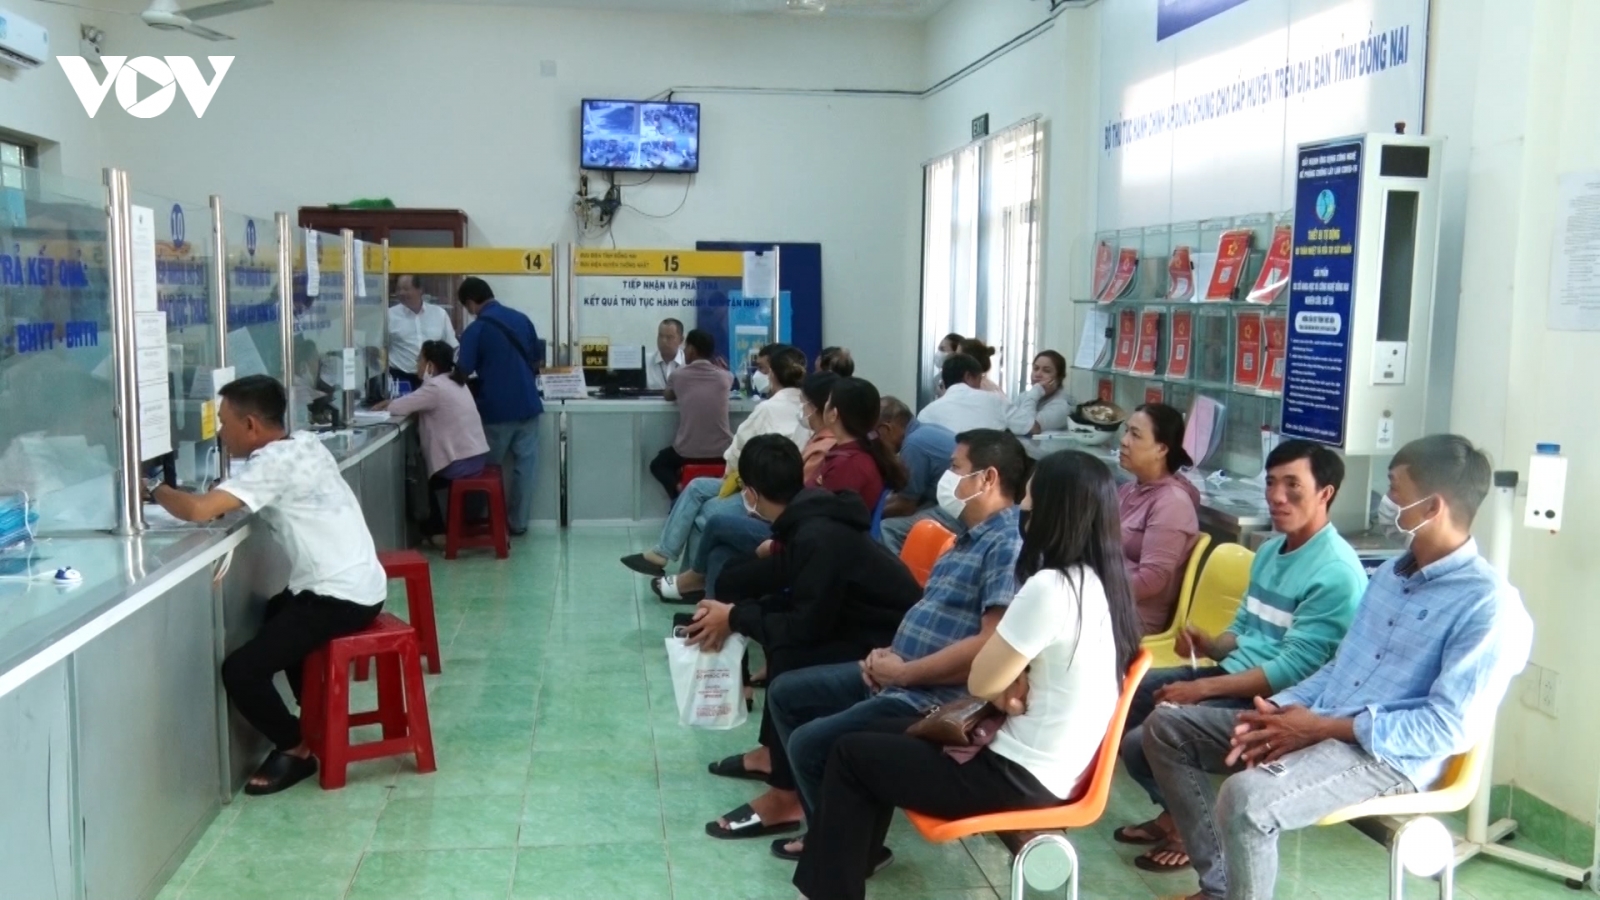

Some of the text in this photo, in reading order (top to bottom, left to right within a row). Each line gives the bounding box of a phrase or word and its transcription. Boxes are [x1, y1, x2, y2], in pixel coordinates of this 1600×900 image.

[1358, 20, 1387, 77] ĐỒNG
[1390, 25, 1409, 69] NAI
[172, 211, 184, 241] 10
[0, 243, 24, 286] RẢ
[27, 244, 55, 286] KẾT
[525, 254, 543, 271] 14
[663, 255, 680, 272] 15
[623, 278, 642, 290] TIẾP
[643, 278, 666, 292] NHẬN
[667, 278, 678, 290] VÀ
[584, 294, 600, 307] KẾT
[601, 294, 619, 307] QUẢ
[620, 294, 637, 307] THỦ
[639, 297, 655, 310] TỤC
[656, 294, 680, 307] HÀNH
[17, 321, 98, 353] BHYT BHTN
